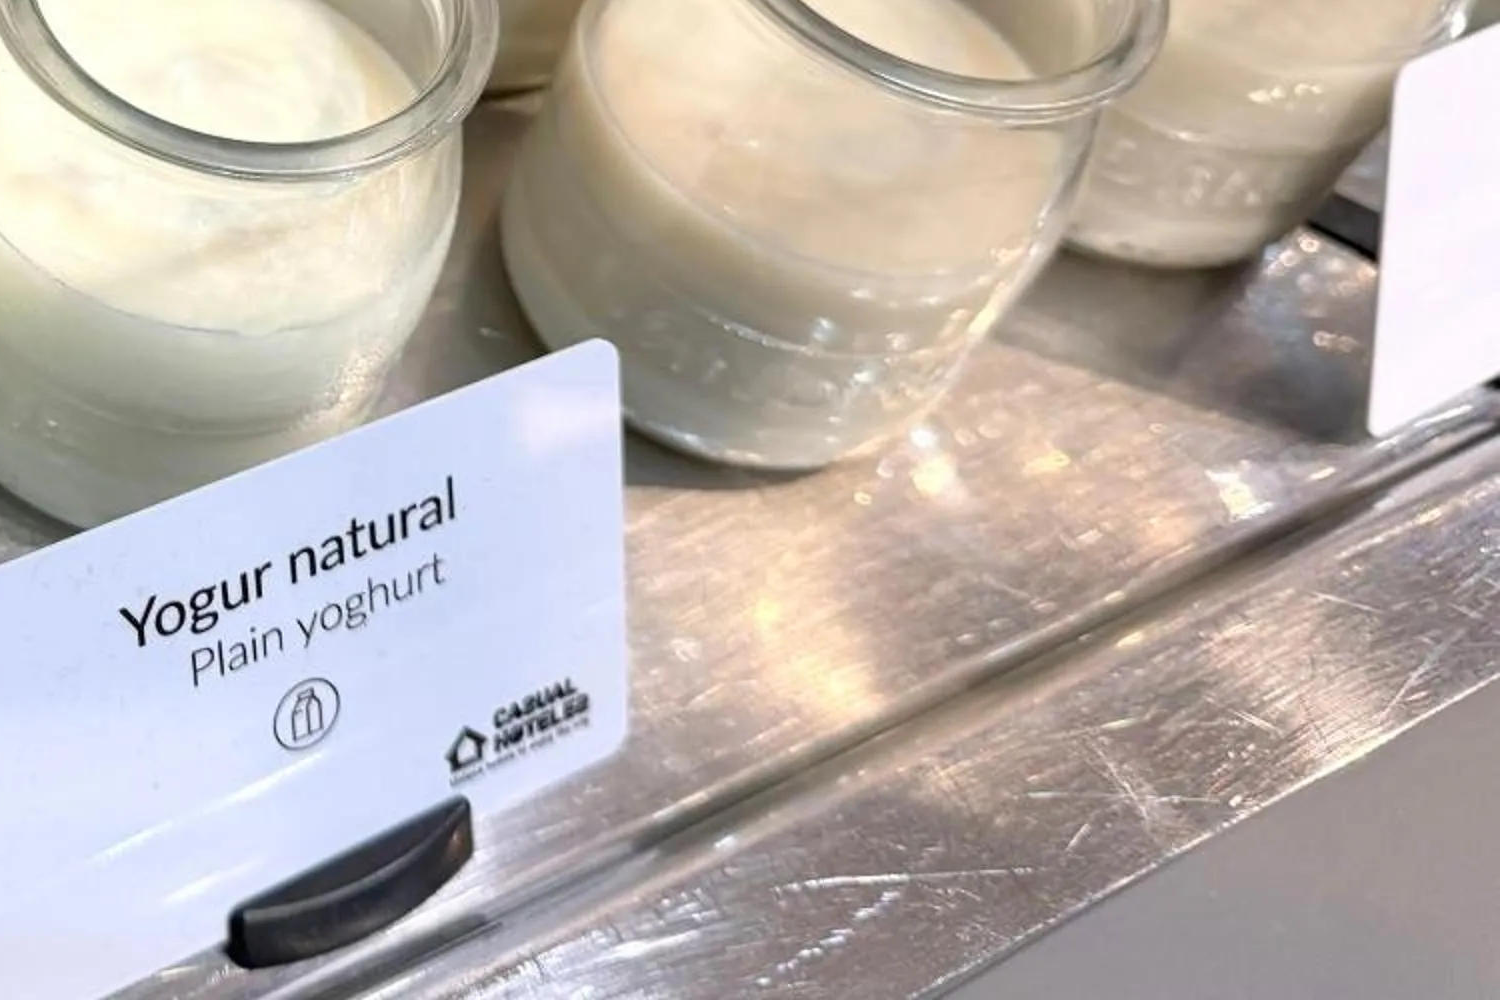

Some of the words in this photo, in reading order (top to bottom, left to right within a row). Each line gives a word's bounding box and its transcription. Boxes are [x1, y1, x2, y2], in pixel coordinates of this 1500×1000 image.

[119, 561, 272, 648] Yogur
[289, 474, 455, 585] natural
[191, 626, 284, 687] Plain
[296, 552, 446, 649] yoghurt
[493, 676, 577, 729] CASUAL
